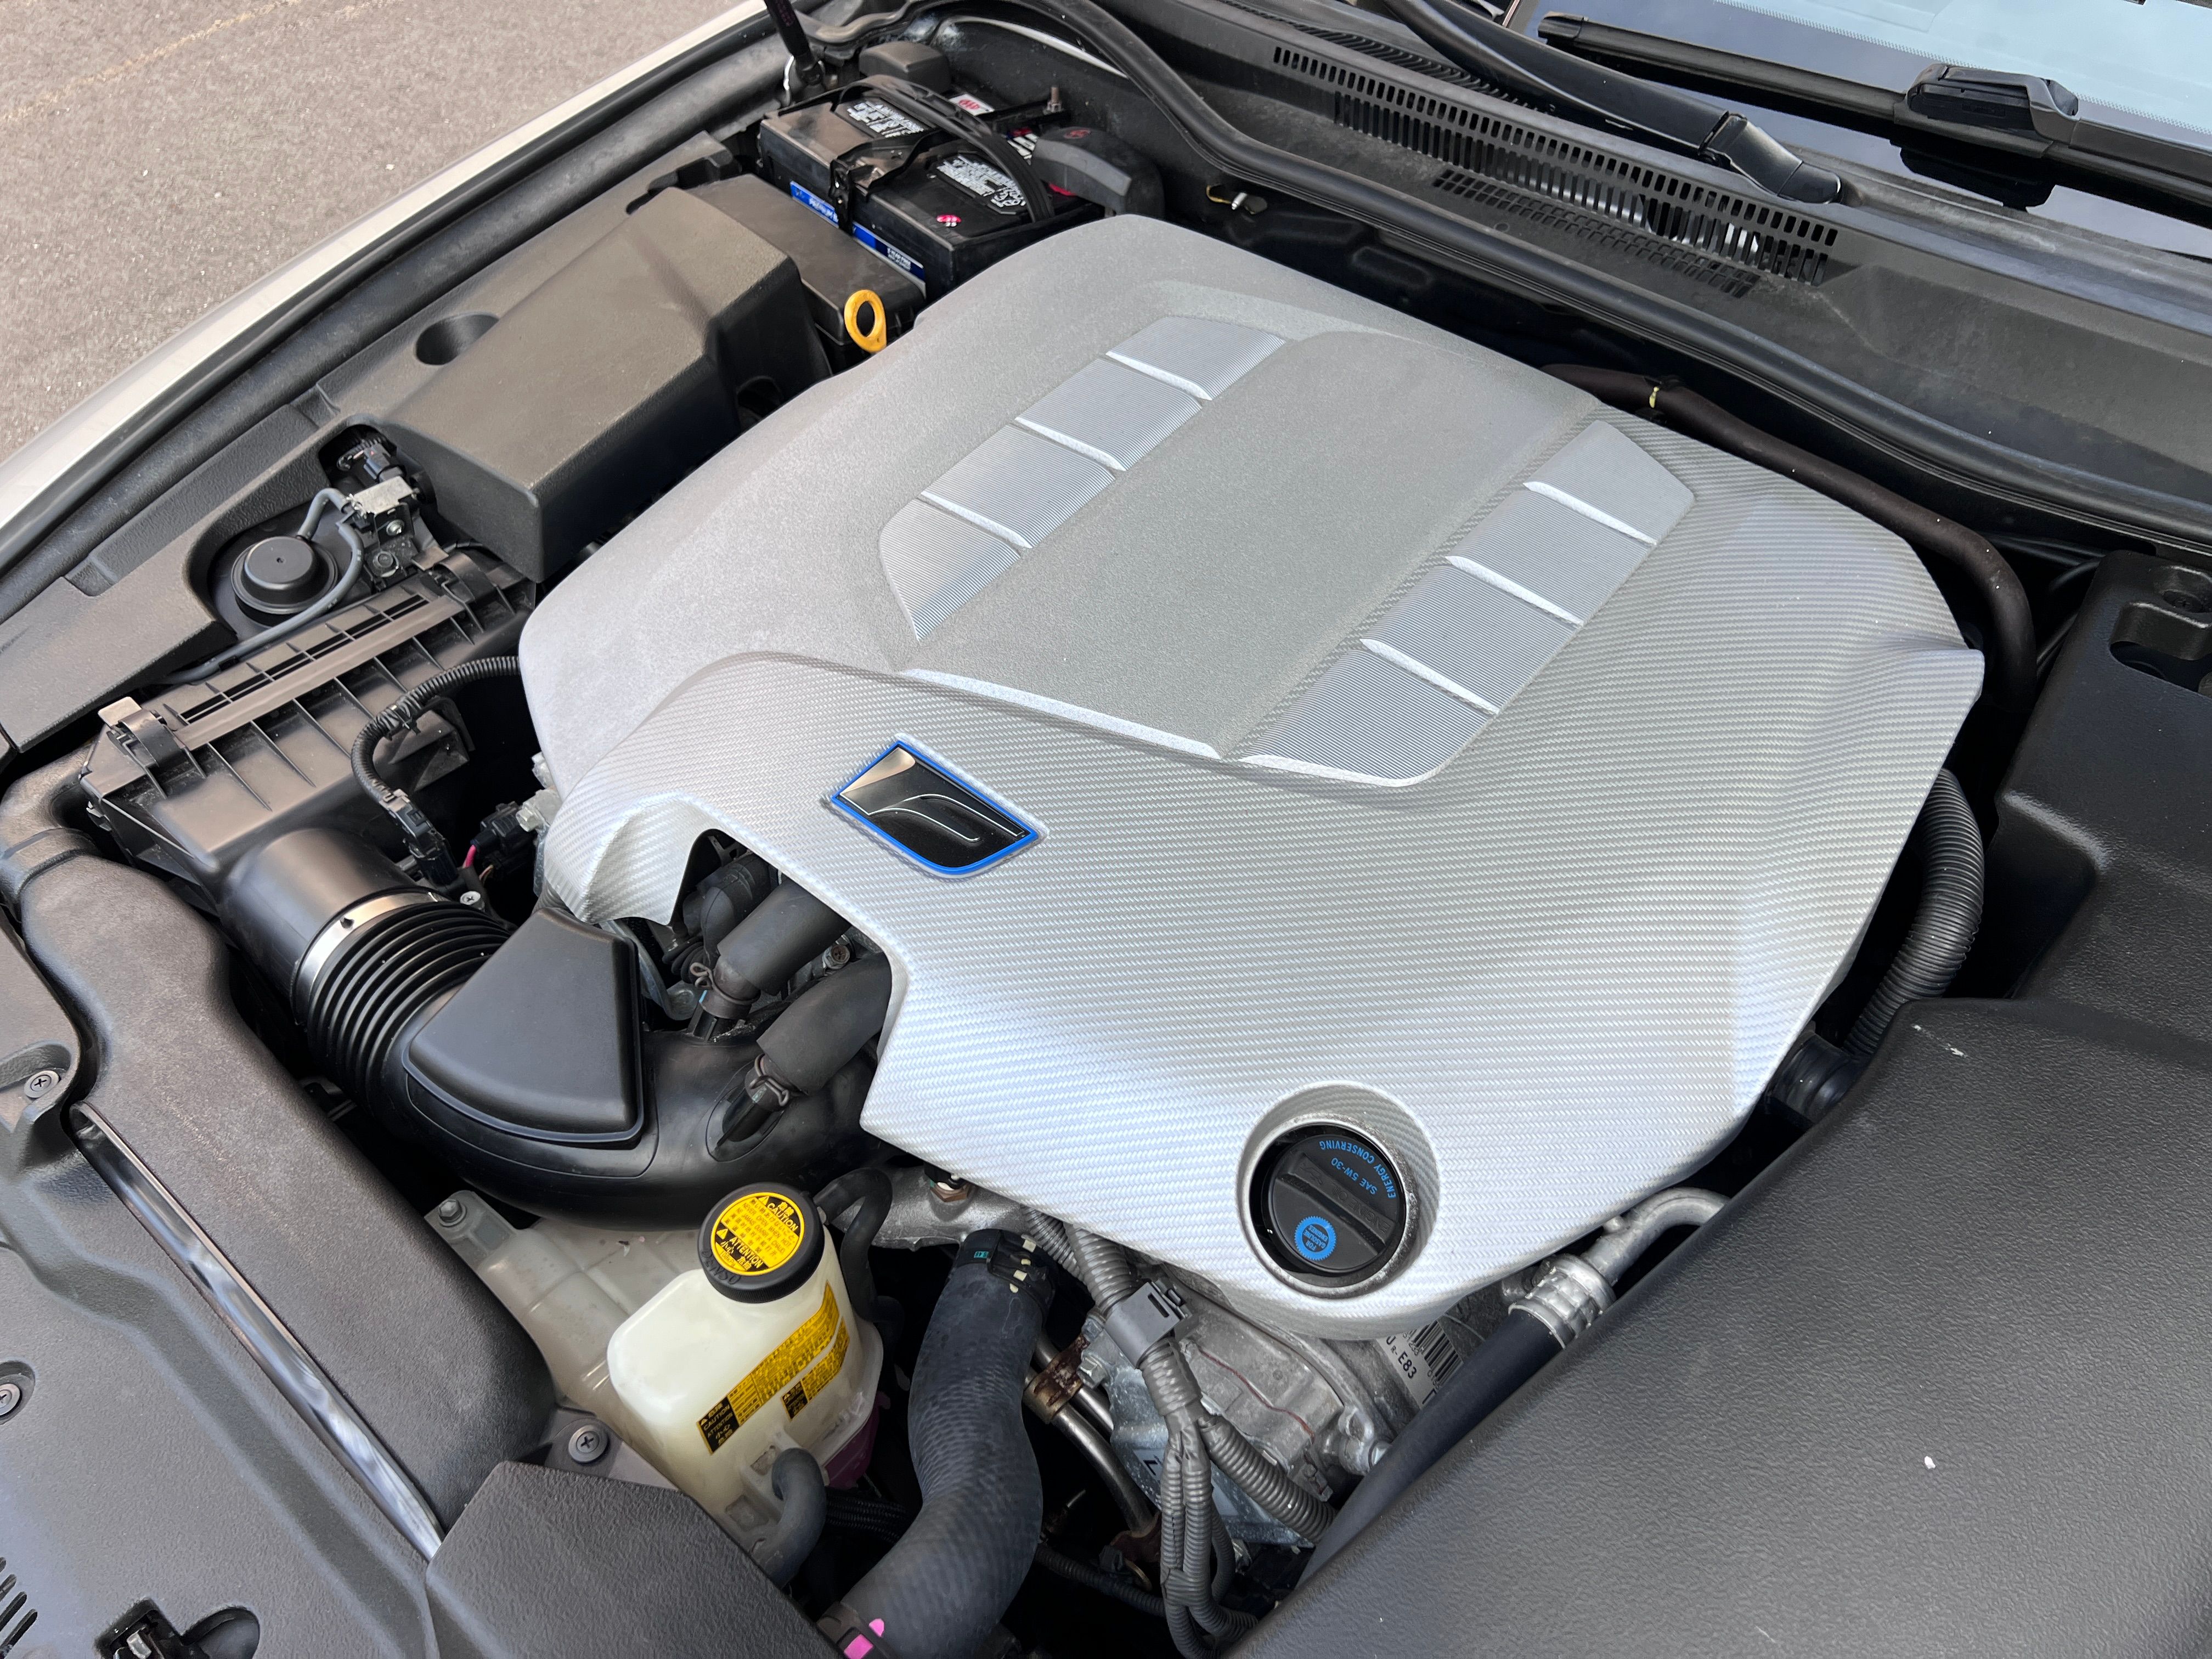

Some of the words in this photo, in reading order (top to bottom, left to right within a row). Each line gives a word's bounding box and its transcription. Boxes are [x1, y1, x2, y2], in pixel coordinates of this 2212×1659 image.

[1319, 1139, 1375, 1164] CONSERVING
[1331, 1157, 1359, 1181] 5W-30
[1373, 1164, 1396, 1199] ENERGY
[1331, 1183, 1348, 1201] OIL
[1359, 1178, 1378, 1195] SAE
[742, 1214, 756, 1226] JAMAIS
[754, 1224, 769, 1238] OUVRIR
[743, 1203, 757, 1215] NEVER
[756, 1215, 768, 1227] OPEN
[768, 1226, 781, 1238] WHEN
[767, 1203, 799, 1232] CAUTION
[1350, 1197, 1392, 1234] ENGINE
[1302, 1229, 1327, 1249] GASOLINE
[1306, 1239, 1317, 1251] FOR
[1308, 1224, 1328, 1242] ENGINES
[720, 1240, 734, 1255] 小心
[729, 1237, 764, 1269] ATTENTION
[701, 1251, 741, 1285] DENSO
[703, 1404, 730, 1431] CAUTION
[708, 1412, 733, 1438] ATTENTION
